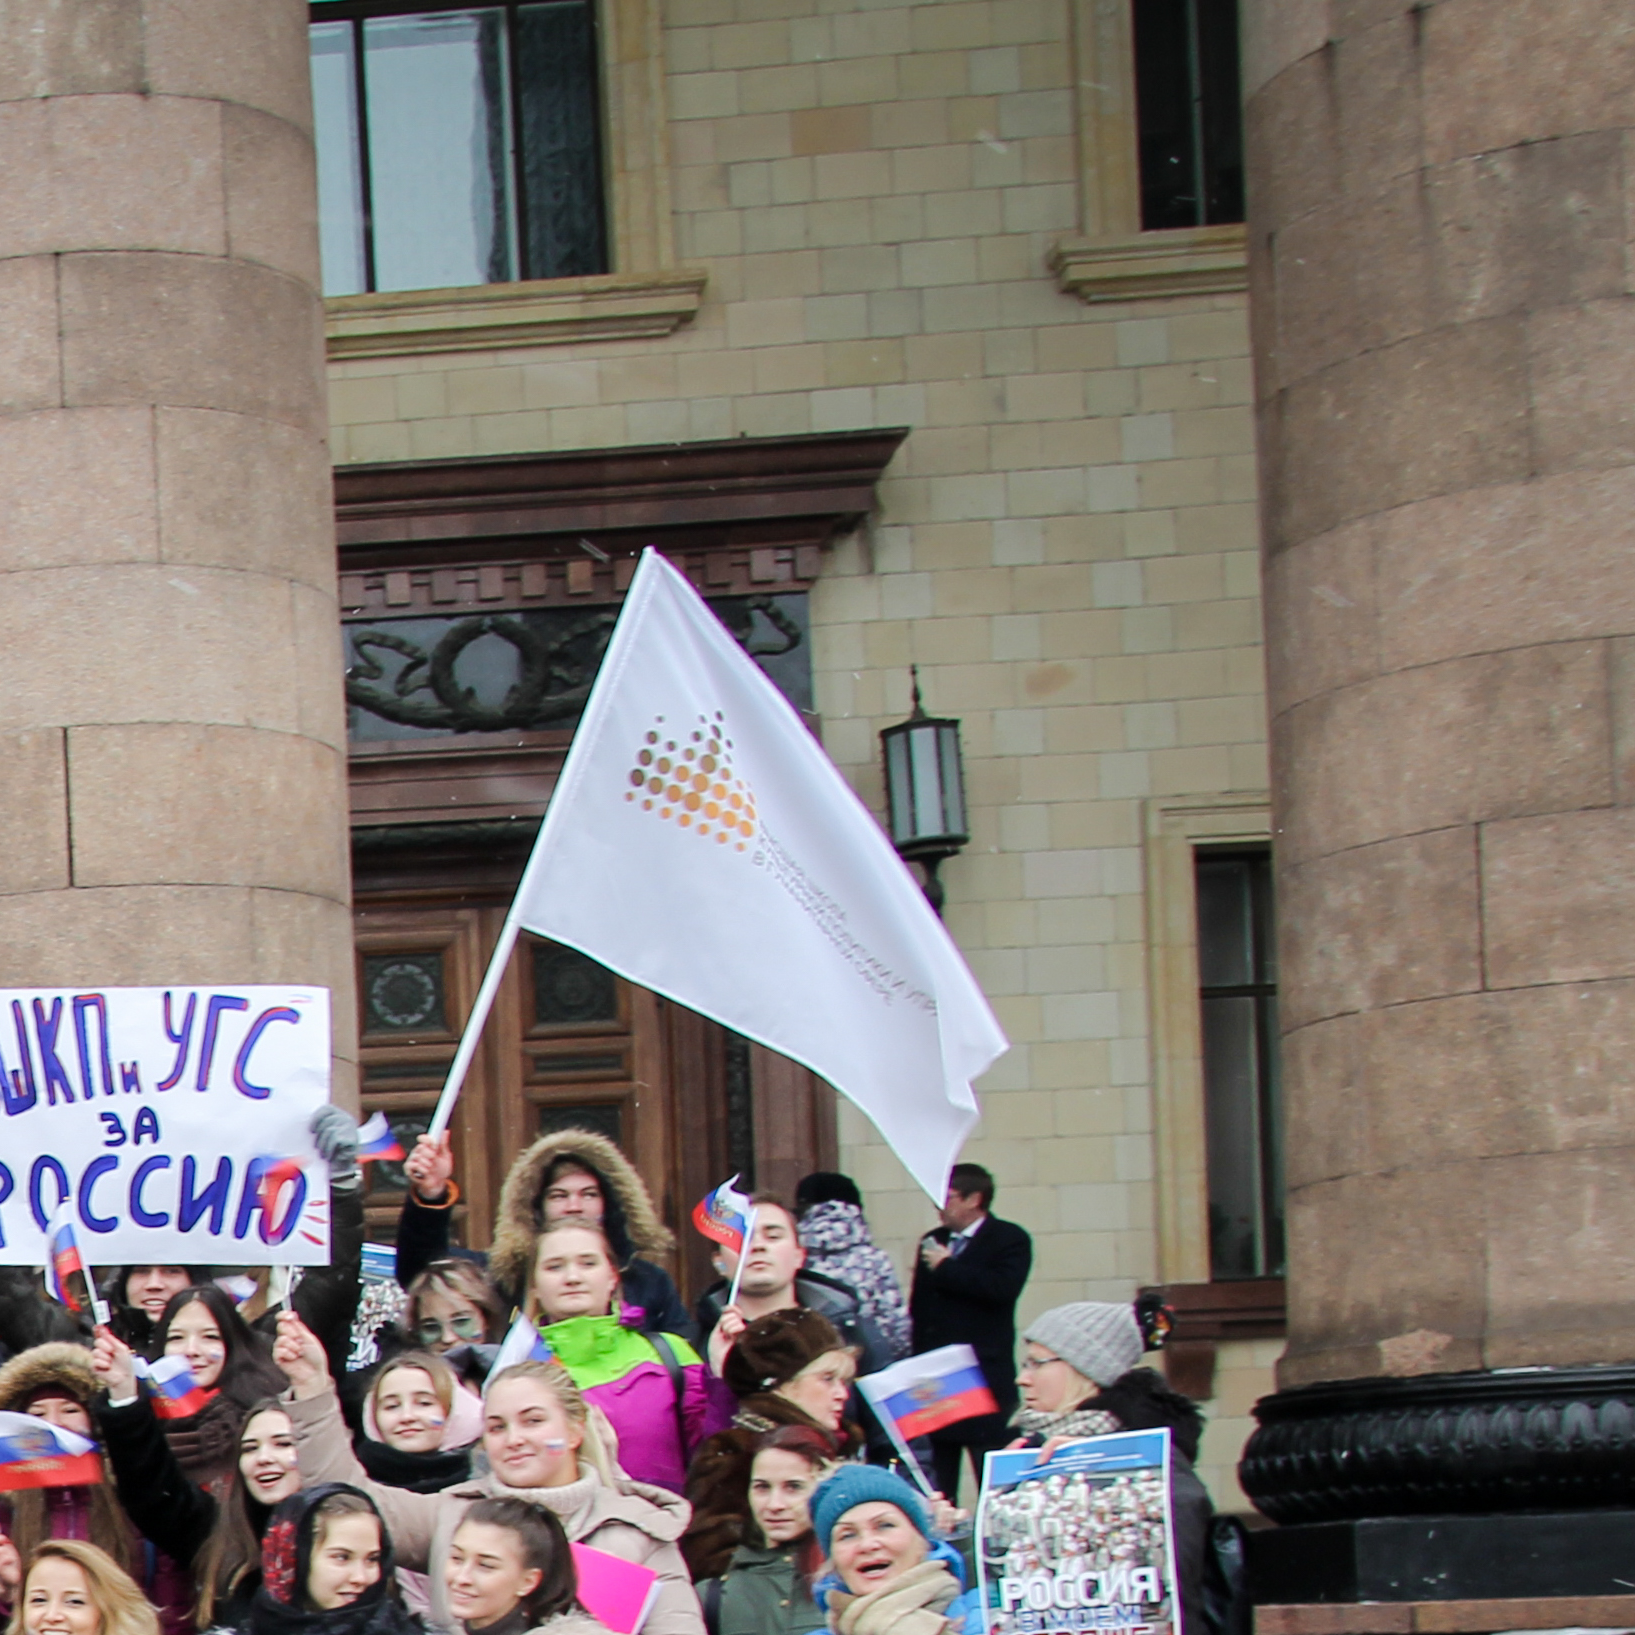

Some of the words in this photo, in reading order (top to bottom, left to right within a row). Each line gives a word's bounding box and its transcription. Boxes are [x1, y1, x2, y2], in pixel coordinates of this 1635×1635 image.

[156, 990, 301, 1100] УГС
[99, 1105, 161, 1148] ЗА
[998, 1566, 1163, 1613] РОССИЯ
